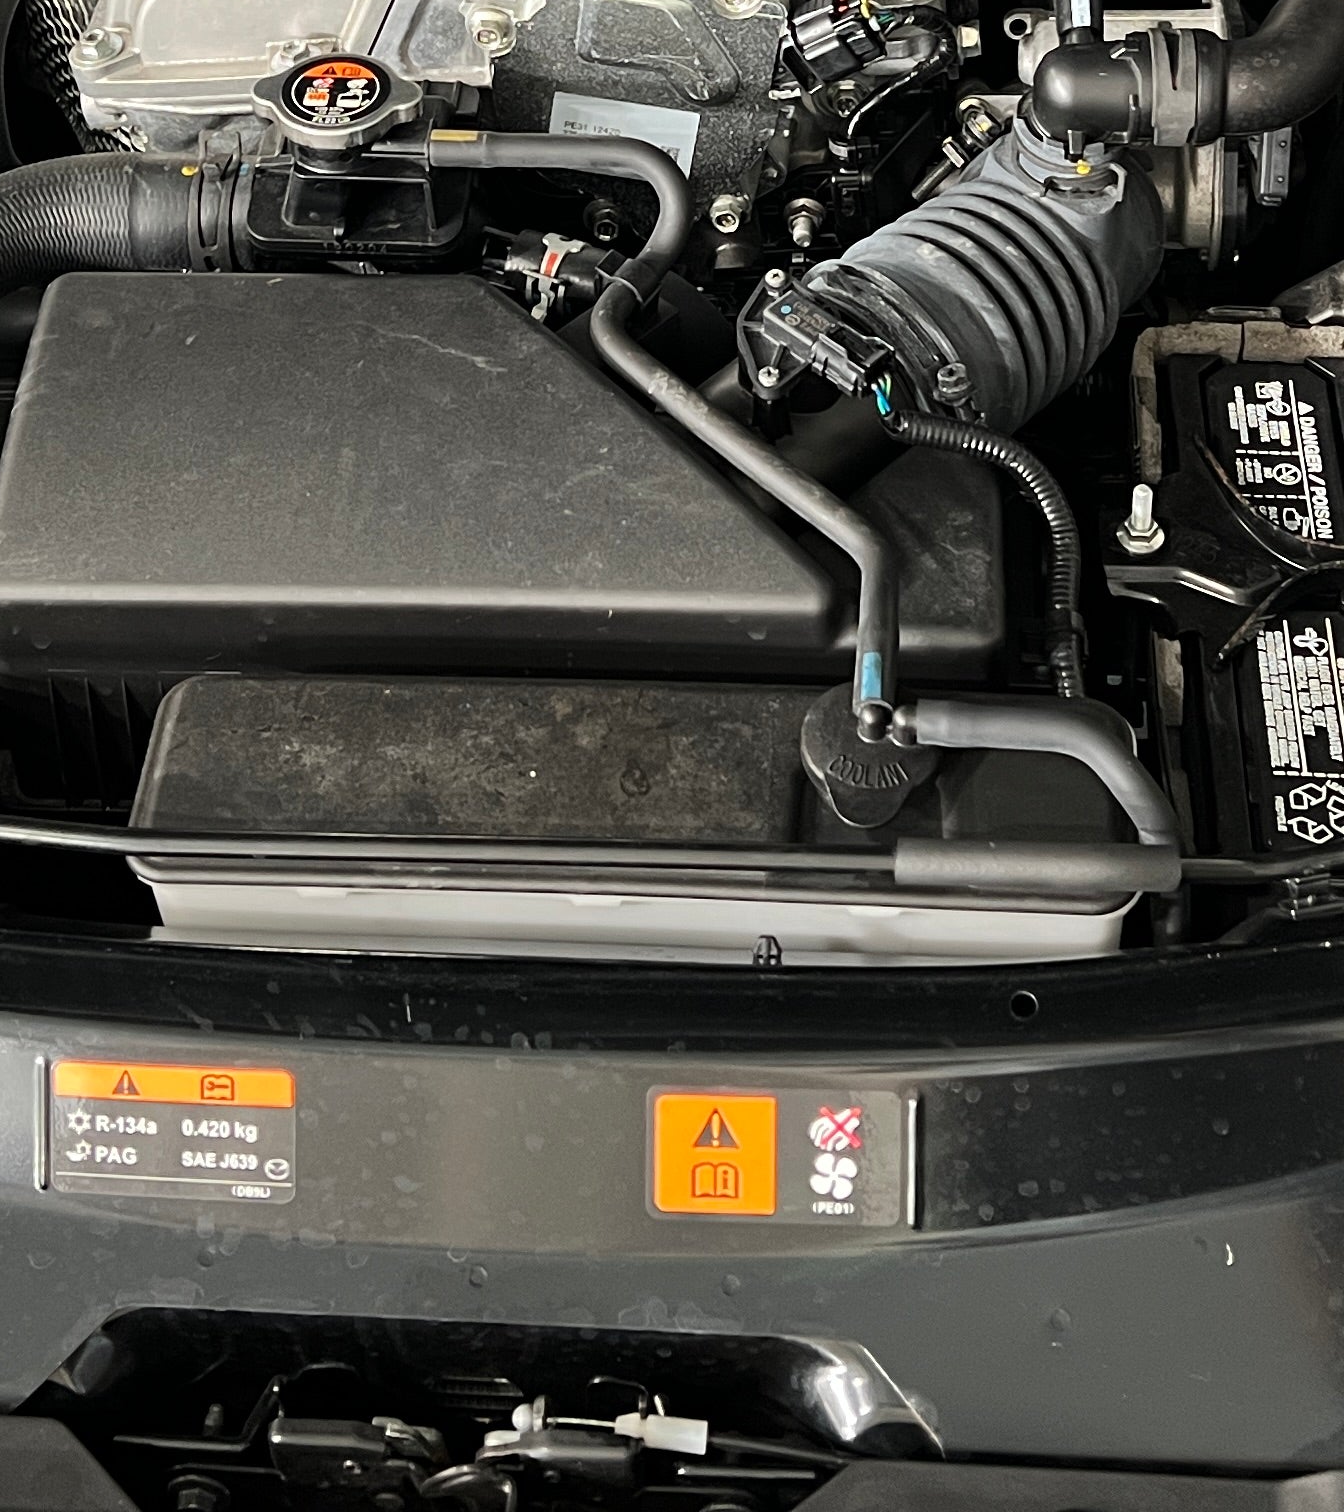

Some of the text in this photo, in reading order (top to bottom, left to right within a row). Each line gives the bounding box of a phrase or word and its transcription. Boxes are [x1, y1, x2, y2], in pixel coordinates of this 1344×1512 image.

[1299, 417, 1322, 472] DANGER
[1310, 487, 1334, 539] POISON
[95, 1115, 258, 1143] R-134a 0.420 kg
[95, 1146, 258, 1170] PAG SAE J639
[812, 1201, 855, 1215] (PE01)
